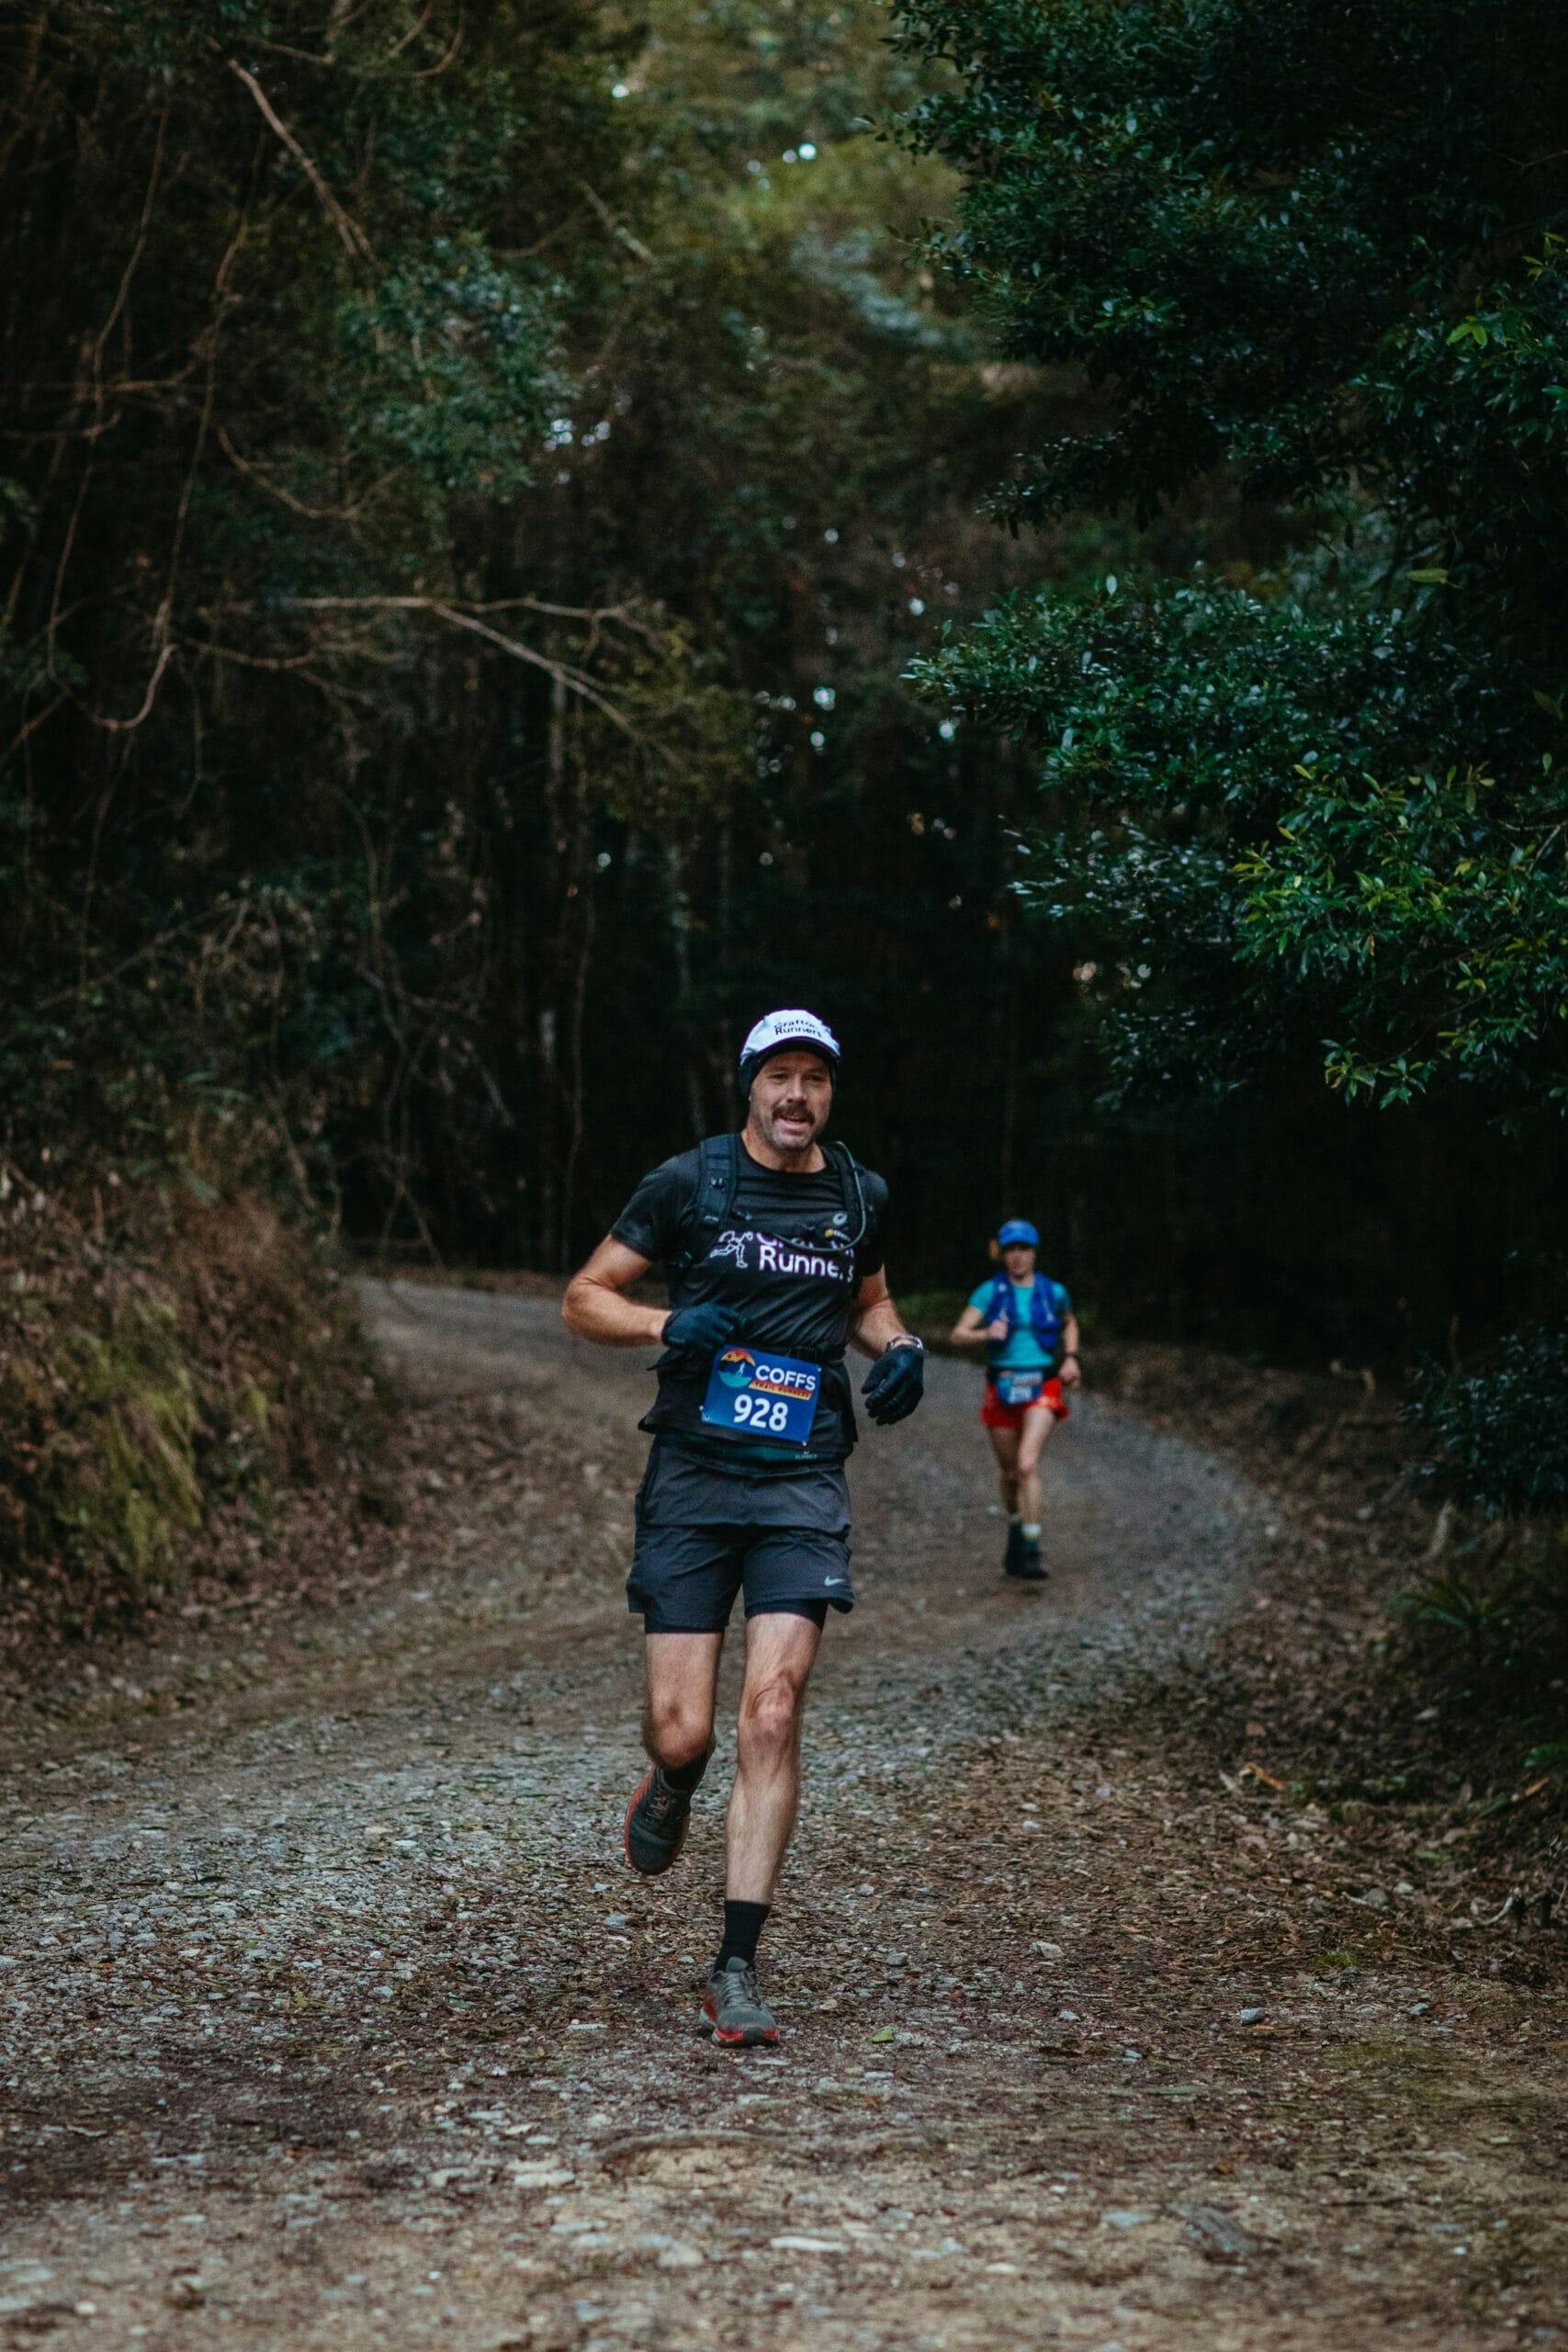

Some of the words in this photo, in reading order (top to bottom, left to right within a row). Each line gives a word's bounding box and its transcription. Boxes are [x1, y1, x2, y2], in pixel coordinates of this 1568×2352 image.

[759, 1244, 854, 1283] Runnes
[755, 1364, 817, 1391] COFFS
[733, 1394, 789, 1431] 928
